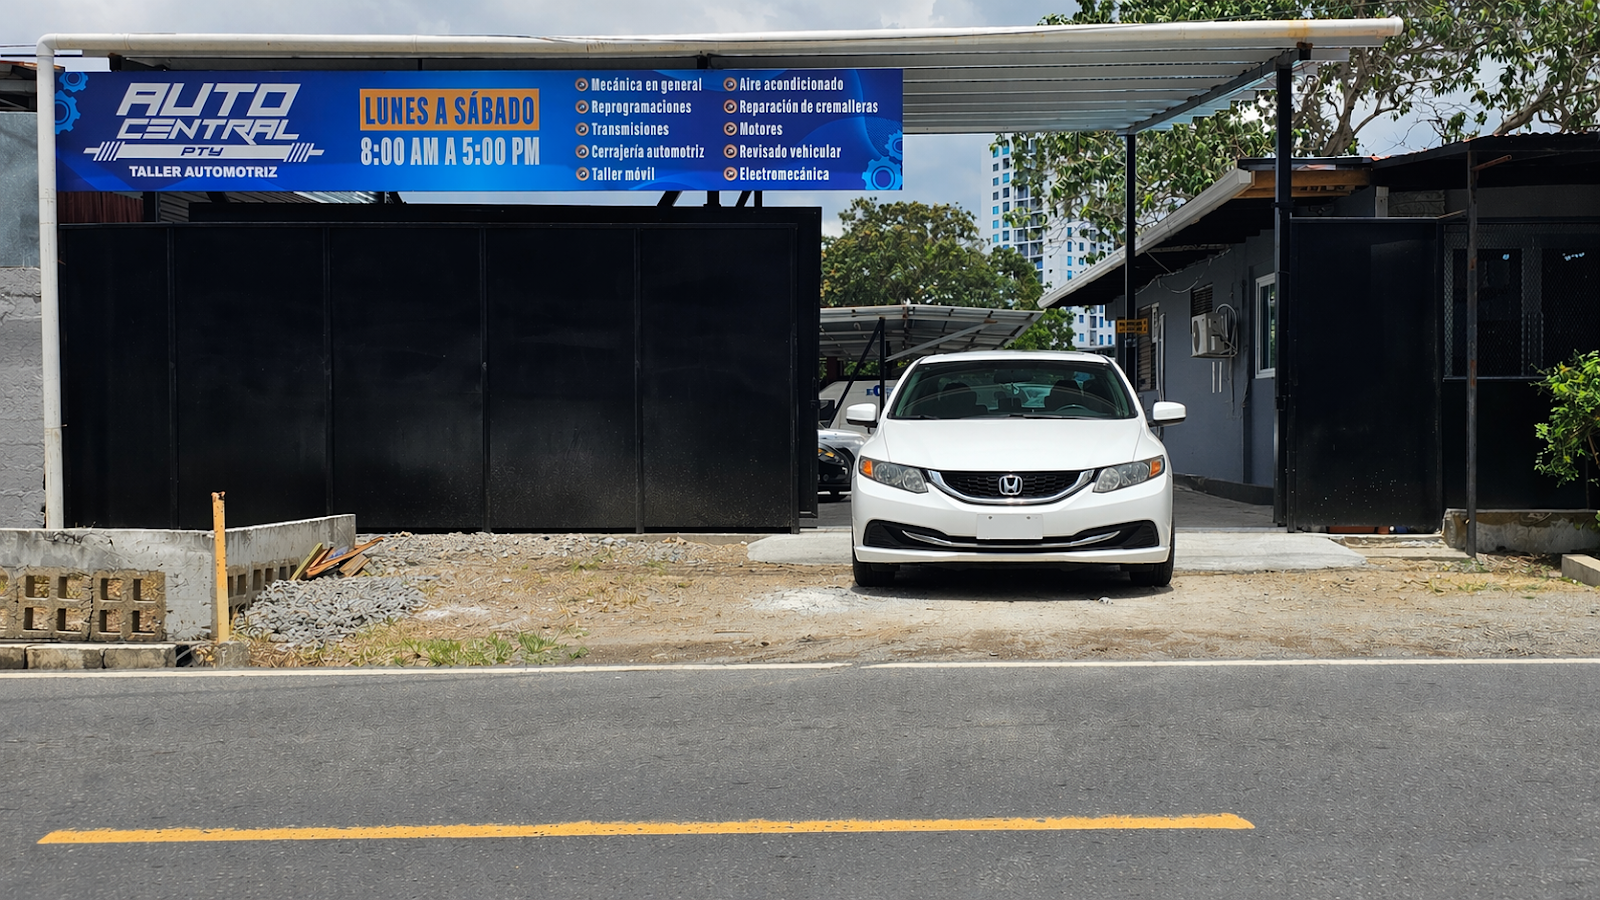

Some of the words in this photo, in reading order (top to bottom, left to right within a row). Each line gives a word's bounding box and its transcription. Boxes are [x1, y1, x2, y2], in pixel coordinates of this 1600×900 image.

[591, 77, 643, 92] Mecánica
[645, 81, 658, 92] en
[661, 77, 702, 95] general
[739, 77, 761, 91] Aire
[764, 77, 844, 91] acondicionado
[116, 83, 301, 116] AUTO
[591, 99, 692, 116] Reprogramaciones
[739, 99, 799, 116] Reparación
[800, 99, 814, 113] de
[816, 99, 878, 113] cremalleras
[365, 96, 429, 125] LUNES
[434, 96, 448, 125] A
[454, 91, 535, 125] SÁBADO
[116, 118, 300, 145] CENTRAL
[592, 122, 669, 136] Transmisiones
[739, 122, 783, 136] Motores
[181, 146, 224, 157] PTY
[361, 137, 405, 166] 8:00
[410, 137, 439, 166] AM
[444, 137, 457, 166] A
[462, 137, 506, 166] 5:00
[511, 137, 540, 166] PM
[591, 144, 644, 161] Cerrajería
[646, 145, 705, 158] automotriz
[739, 144, 787, 158] Revisado
[789, 144, 842, 158] vehicular
[129, 165, 182, 178] TALLER
[184, 165, 278, 178] AUTOMOTRIZ
[592, 167, 623, 181] Taller
[625, 166, 655, 181] móvil
[739, 166, 830, 181] Electromecánica
